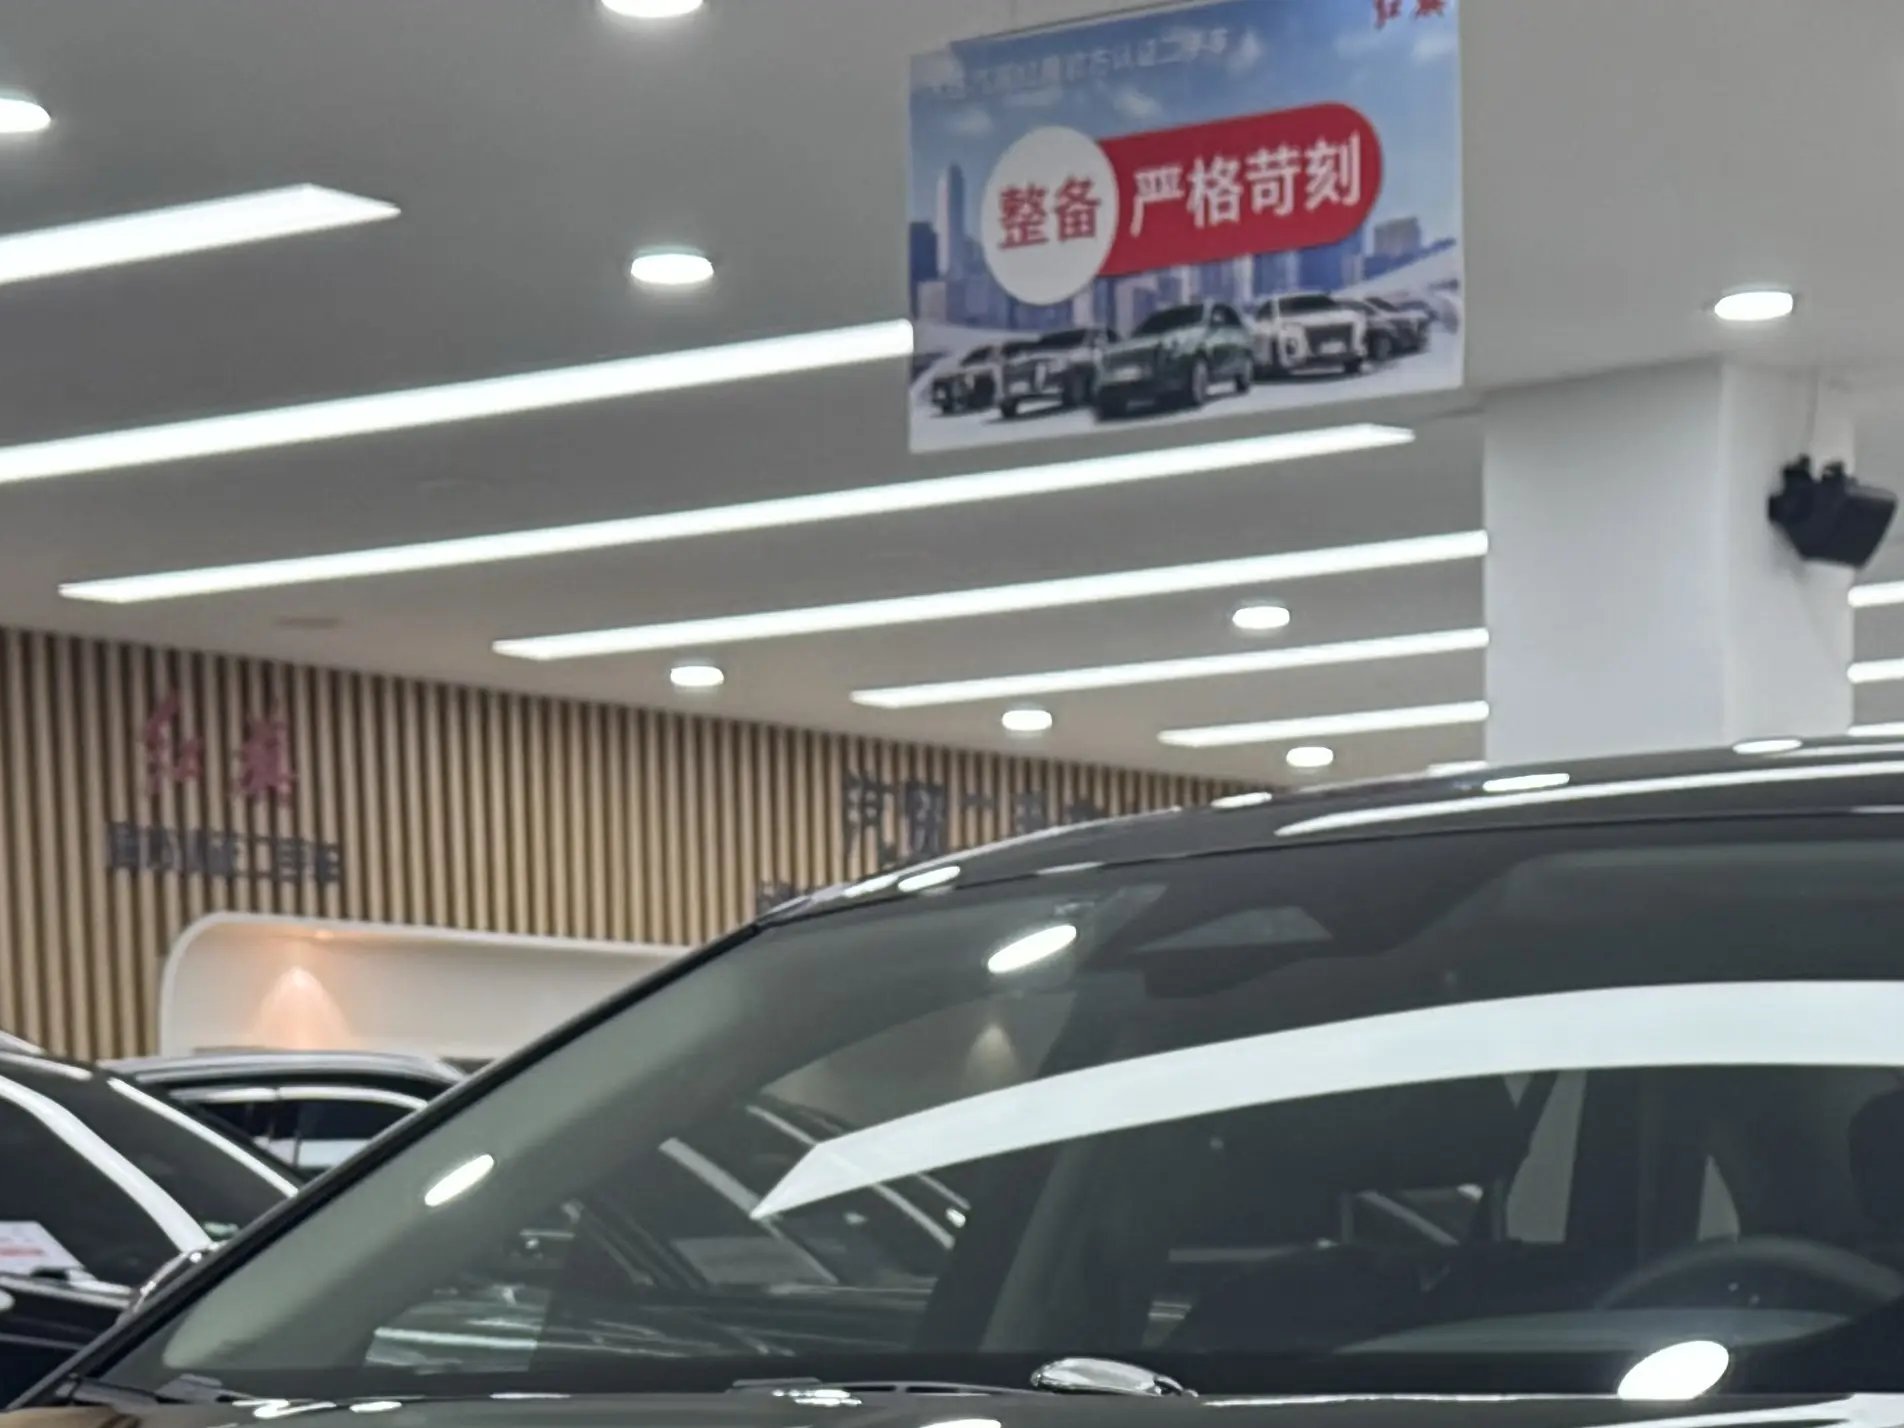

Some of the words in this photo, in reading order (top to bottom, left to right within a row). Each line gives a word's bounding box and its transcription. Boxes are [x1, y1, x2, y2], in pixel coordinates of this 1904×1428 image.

[999, 177, 1102, 251] 整备
[1129, 131, 1363, 238] 严格苛刻
